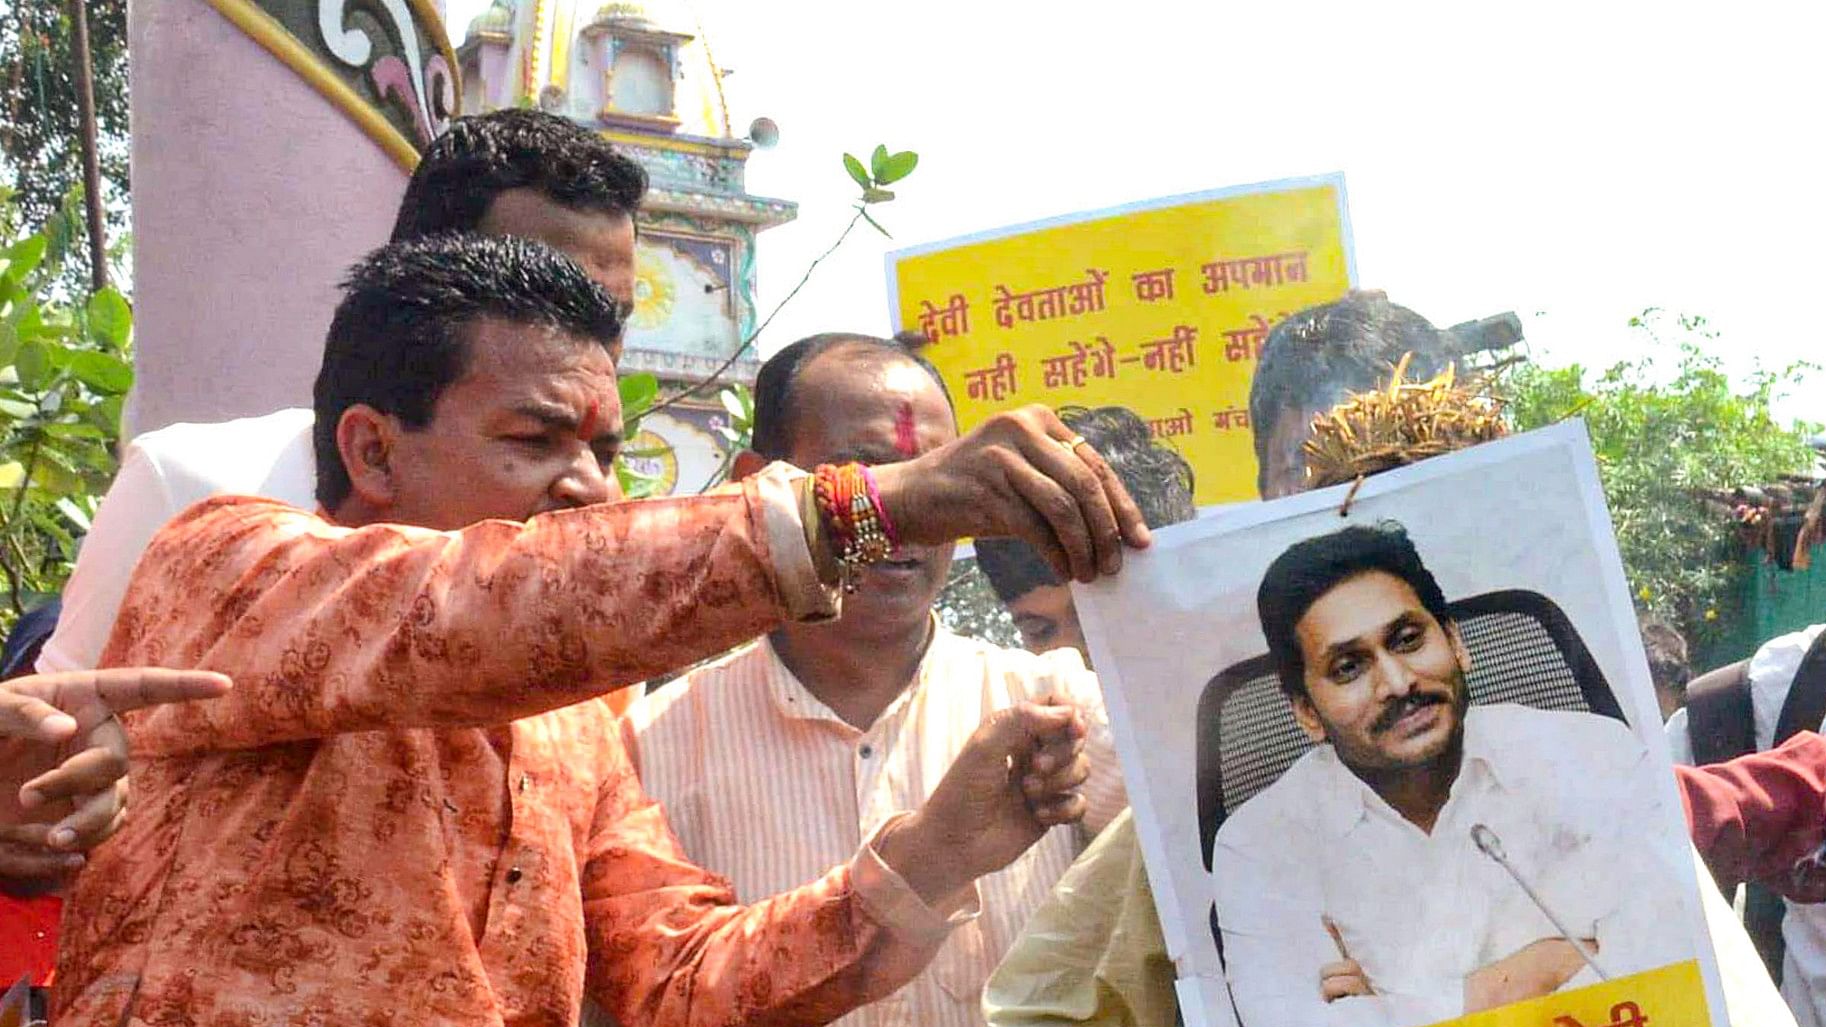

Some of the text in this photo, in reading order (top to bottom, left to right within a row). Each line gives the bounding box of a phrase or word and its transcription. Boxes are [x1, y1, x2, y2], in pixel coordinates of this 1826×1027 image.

[918, 251, 1309, 345] देवी देवताओं का अपमान
[965, 351, 1018, 401] नही
